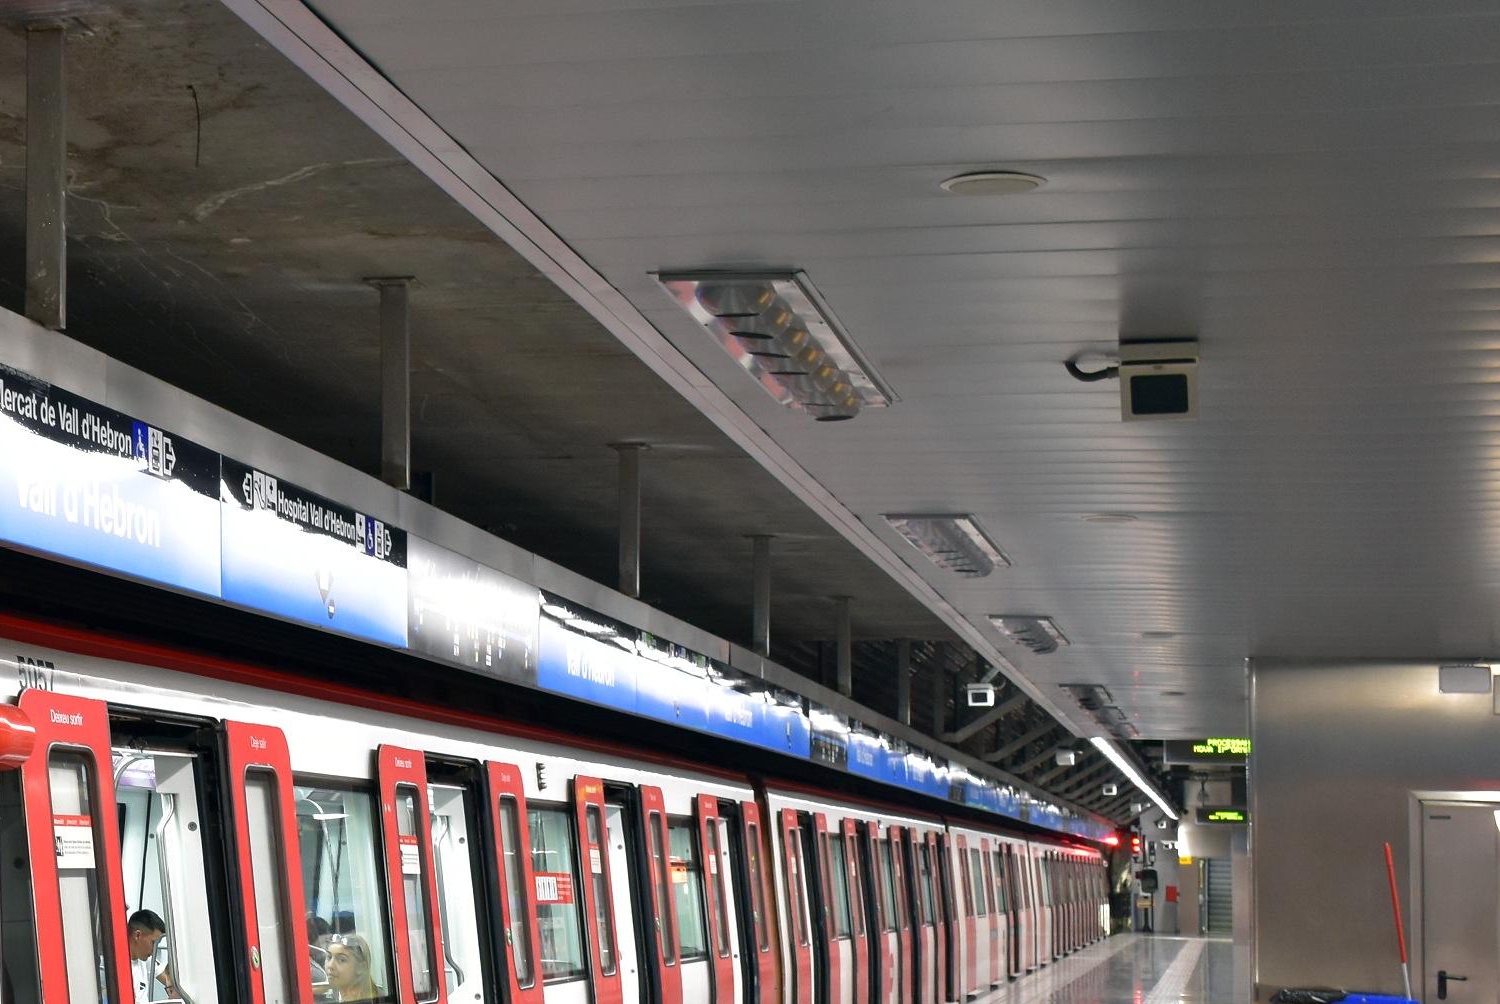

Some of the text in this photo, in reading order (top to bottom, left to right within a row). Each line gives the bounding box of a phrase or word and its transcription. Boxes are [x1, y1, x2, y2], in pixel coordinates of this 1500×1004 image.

[40, 395, 56, 427] de
[58, 401, 79, 436] Vall
[81, 412, 133, 456] d'Hebron
[277, 489, 356, 541] Hospital Vall d'Hebron
[17, 655, 55, 692] 5057
